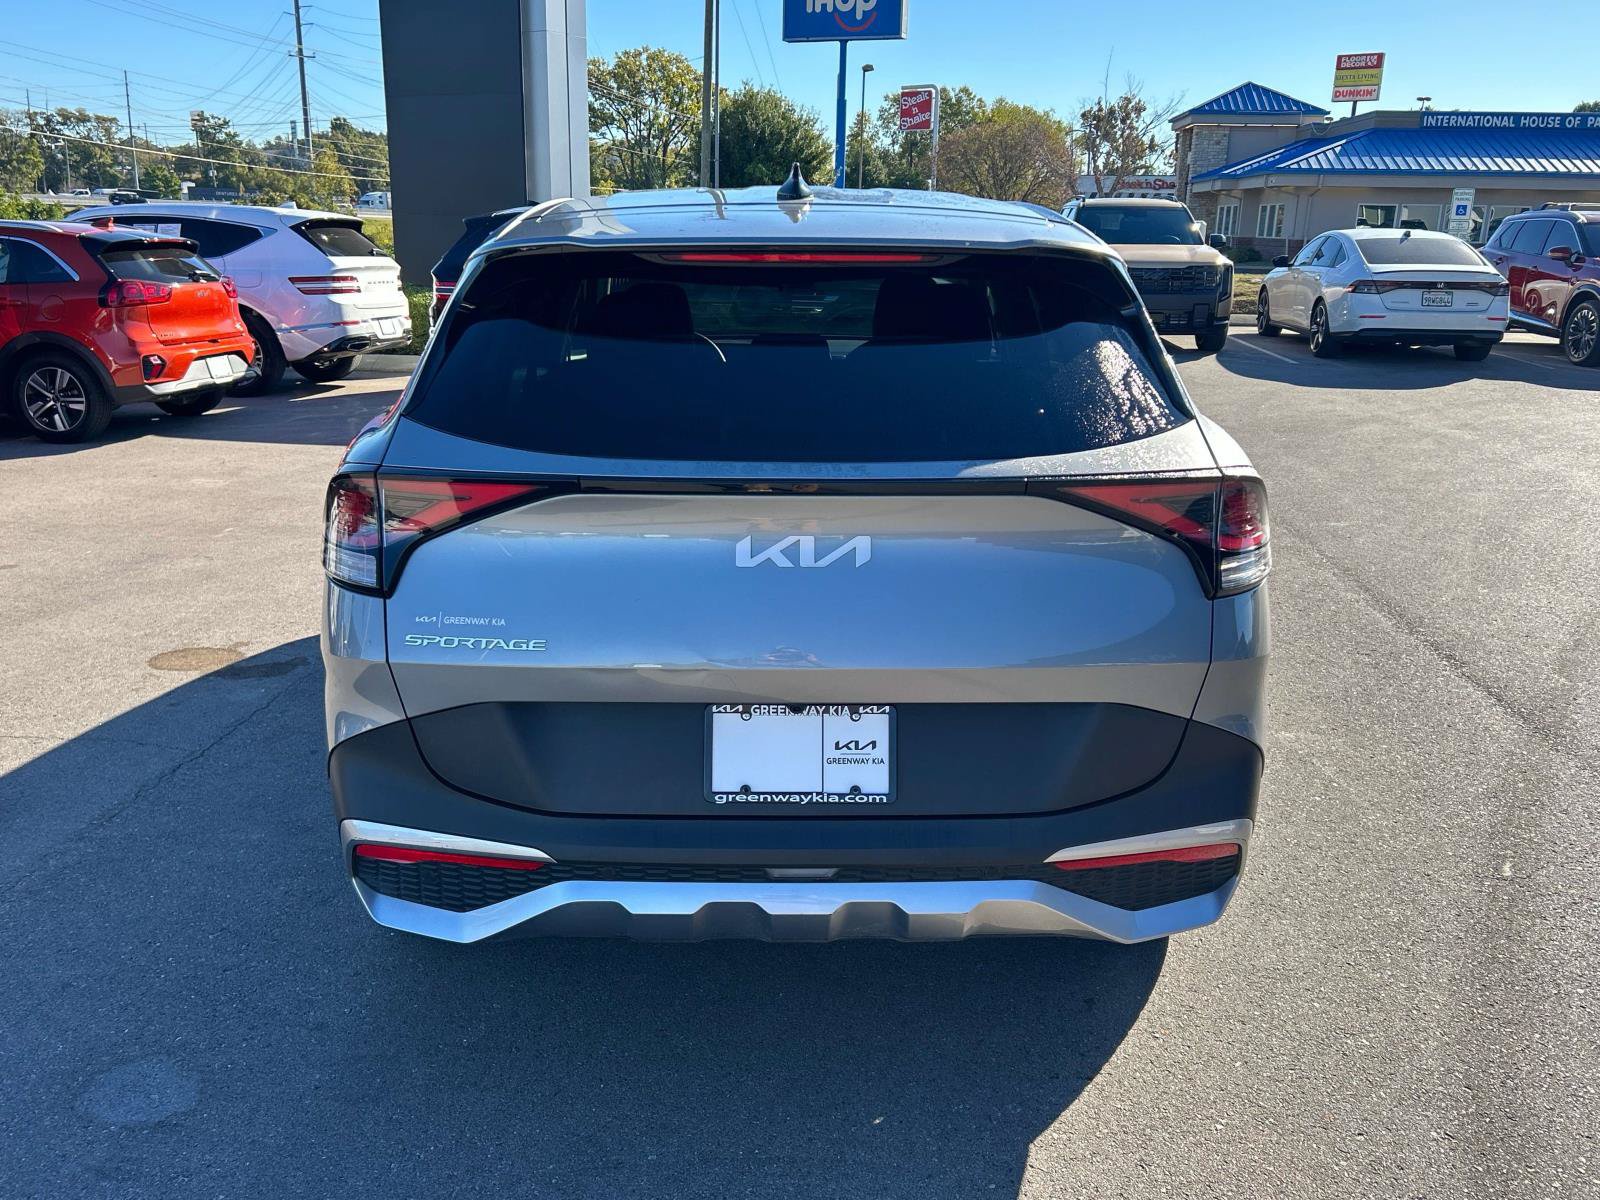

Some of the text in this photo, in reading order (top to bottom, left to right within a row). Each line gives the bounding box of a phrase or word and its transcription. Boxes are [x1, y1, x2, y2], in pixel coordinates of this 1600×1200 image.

[1334, 88, 1376, 98] DUNKIN'
[901, 91, 930, 110] Steak
[900, 112, 931, 130] Shake
[1423, 115, 1515, 128] INTERNATIONAL
[1520, 115, 1561, 128] HOUSE
[1565, 116, 1581, 128] OF
[736, 535, 872, 568] KIA
[415, 616, 506, 626] KIA GREENWAY KIA
[405, 634, 546, 651] SPORTAGE
[712, 704, 743, 714] KIA
[829, 705, 851, 717] KIA
[859, 705, 889, 714] KIA
[834, 740, 877, 751] KIA
[826, 757, 885, 766] GREENWAY KIA
[714, 791, 887, 804] greenwaykia.com
